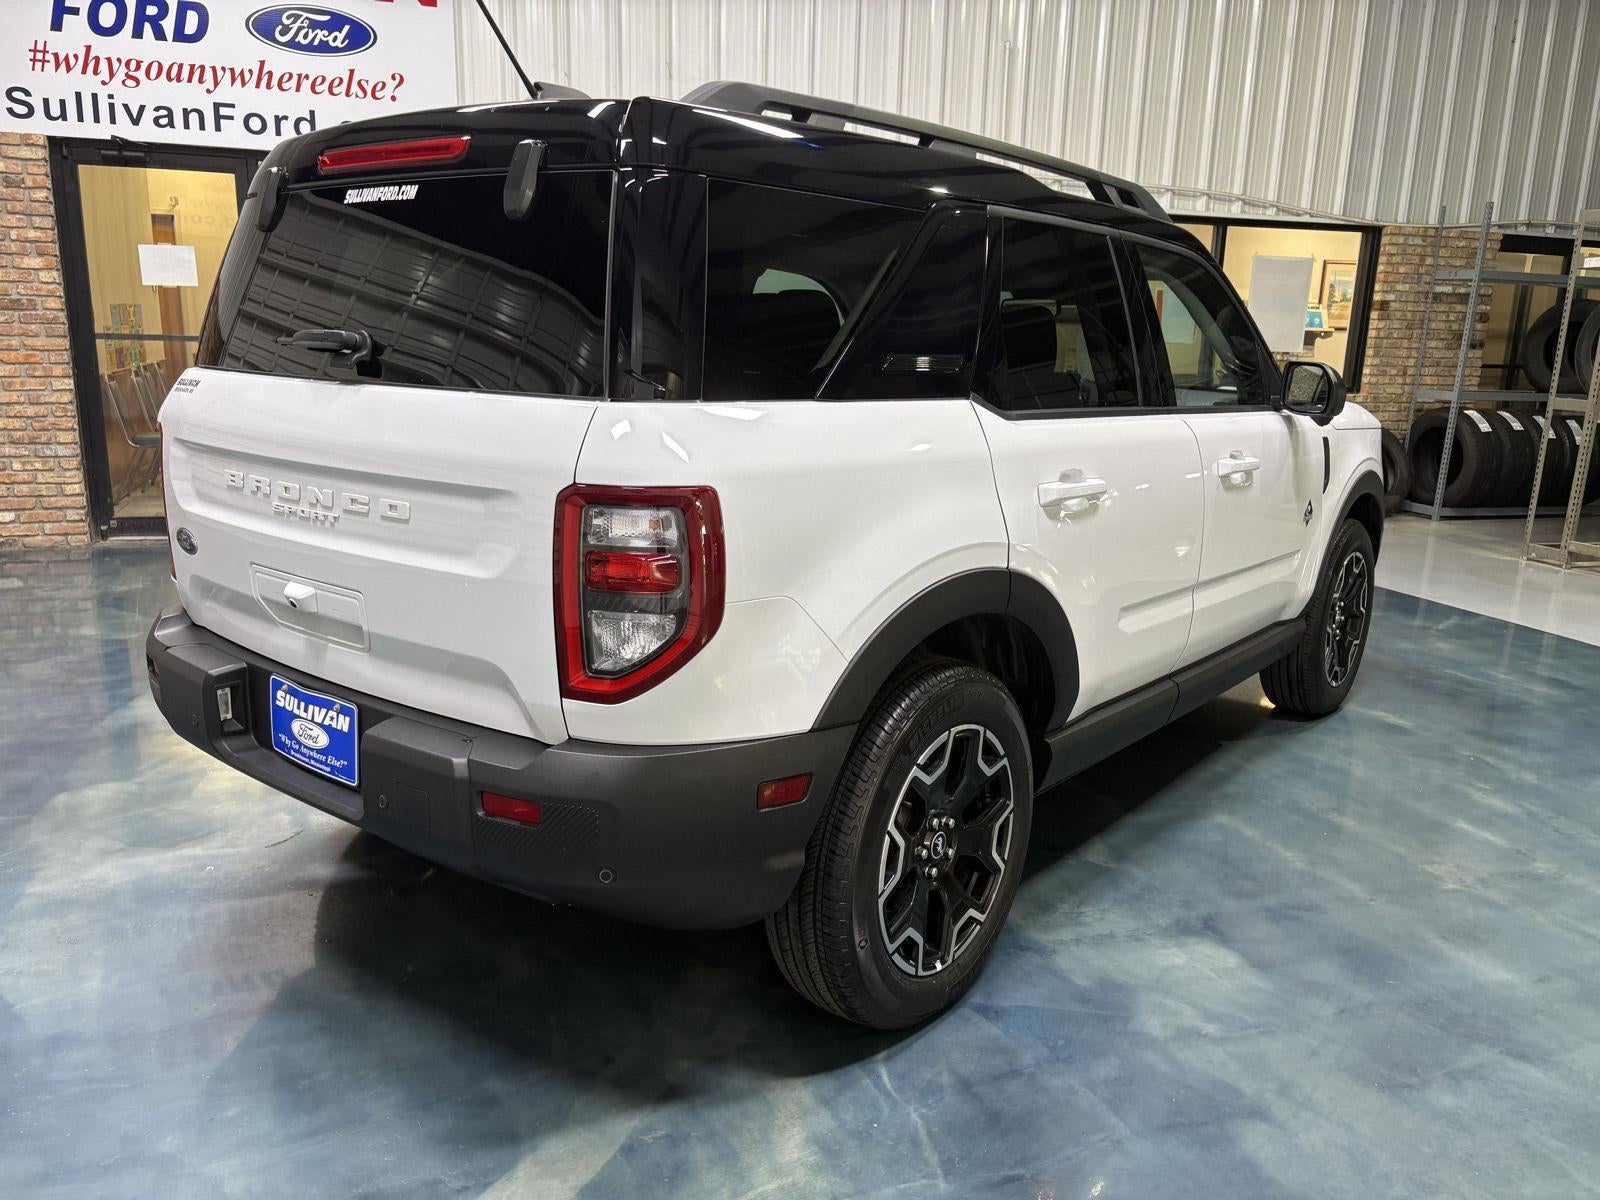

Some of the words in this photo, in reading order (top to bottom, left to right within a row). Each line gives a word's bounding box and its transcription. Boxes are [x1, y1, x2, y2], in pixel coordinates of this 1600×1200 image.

[49, 0, 210, 45] FORD
[274, 9, 351, 49] Ford
[28, 39, 405, 102] #whygoanywhereelse?
[4, 86, 352, 137] SullivanFord
[343, 184, 419, 205] SULLIVANFORD.COM
[224, 470, 411, 521] BRONCO
[271, 501, 340, 527] SPORT
[276, 690, 350, 732] SULLIVAN
[291, 739, 300, 750] Go
[299, 743, 327, 763] Anywhere
[298, 724, 319, 744] Ford
